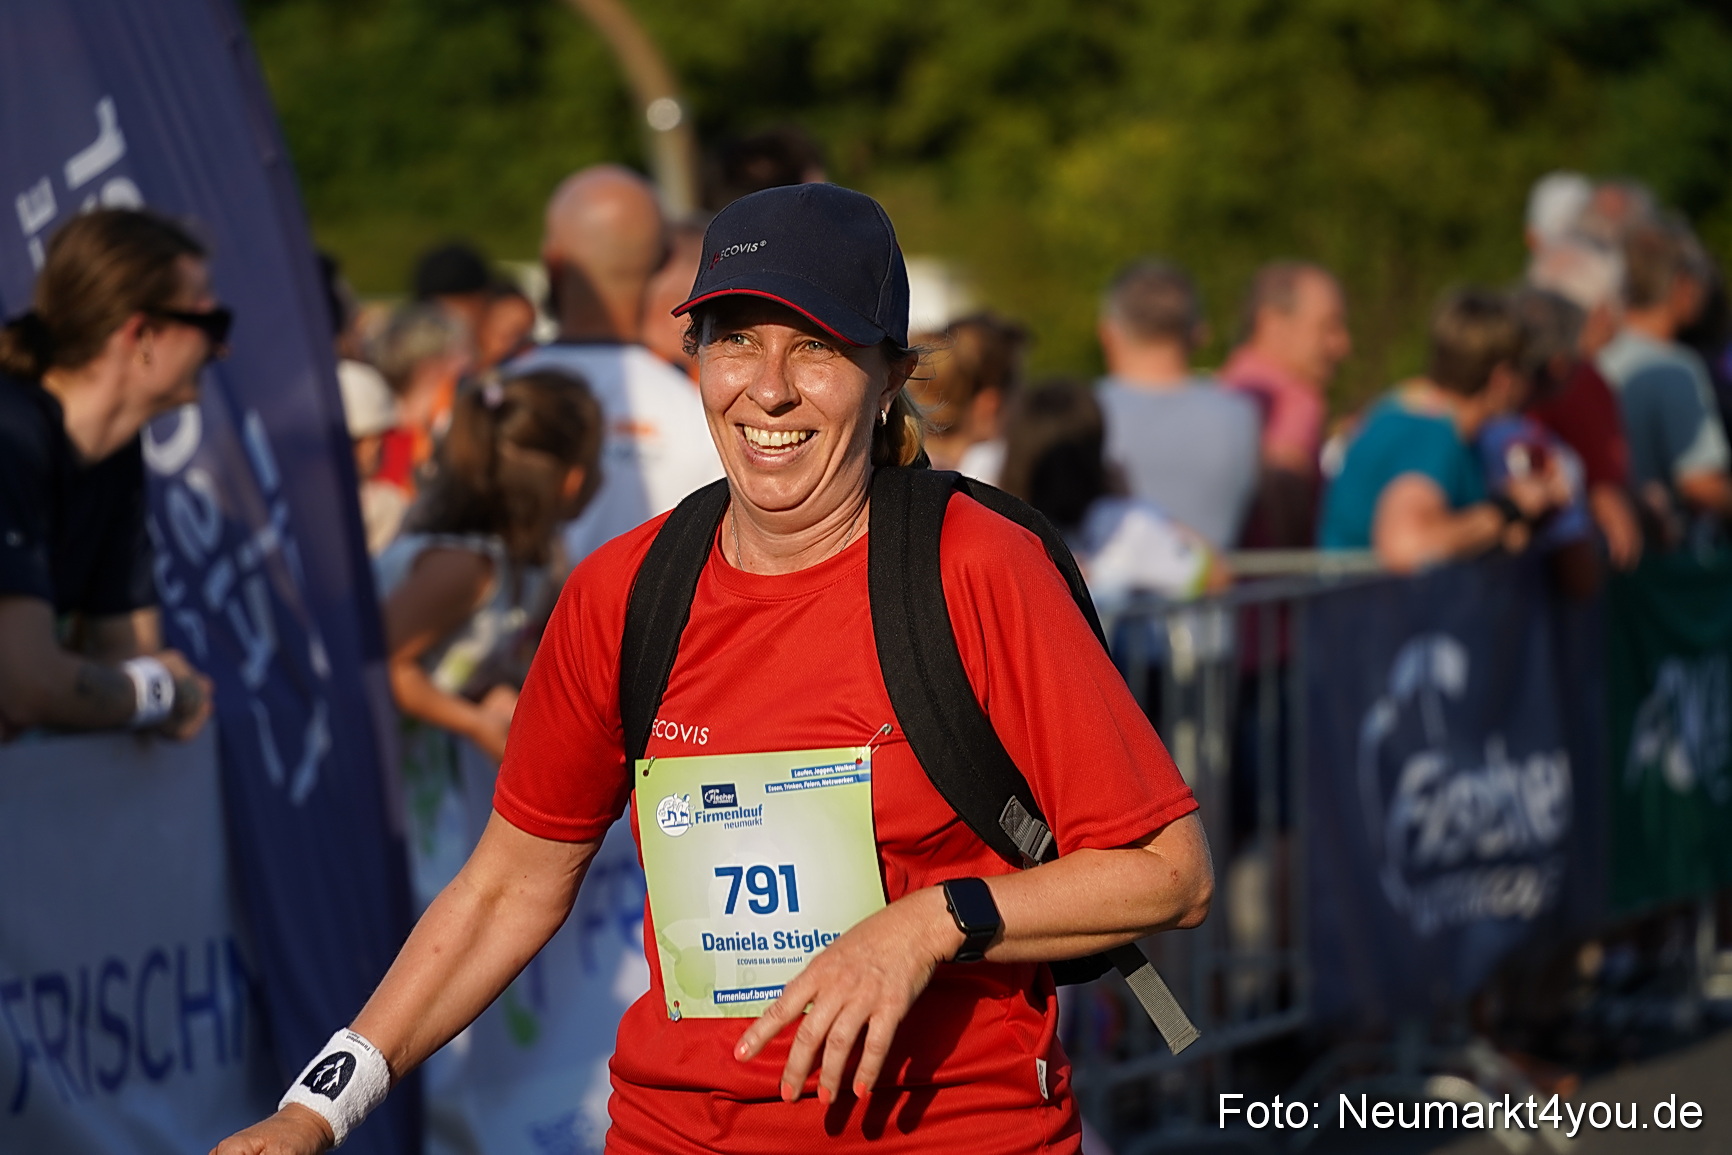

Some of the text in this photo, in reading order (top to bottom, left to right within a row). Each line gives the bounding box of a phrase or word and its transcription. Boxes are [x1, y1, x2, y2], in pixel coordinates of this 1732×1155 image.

[794, 763, 856, 778] Laufen, Joggen, Walken
[784, 782, 803, 791] Trinken,
[804, 779, 822, 788] Feiern,
[822, 776, 854, 786] Netzwerken
[695, 804, 763, 824] Firmenlauf
[724, 817, 763, 830] neumarkt
[714, 864, 800, 915] 791
[701, 931, 769, 951] Daniela
[716, 988, 783, 1003] firmenlauf.bayern
